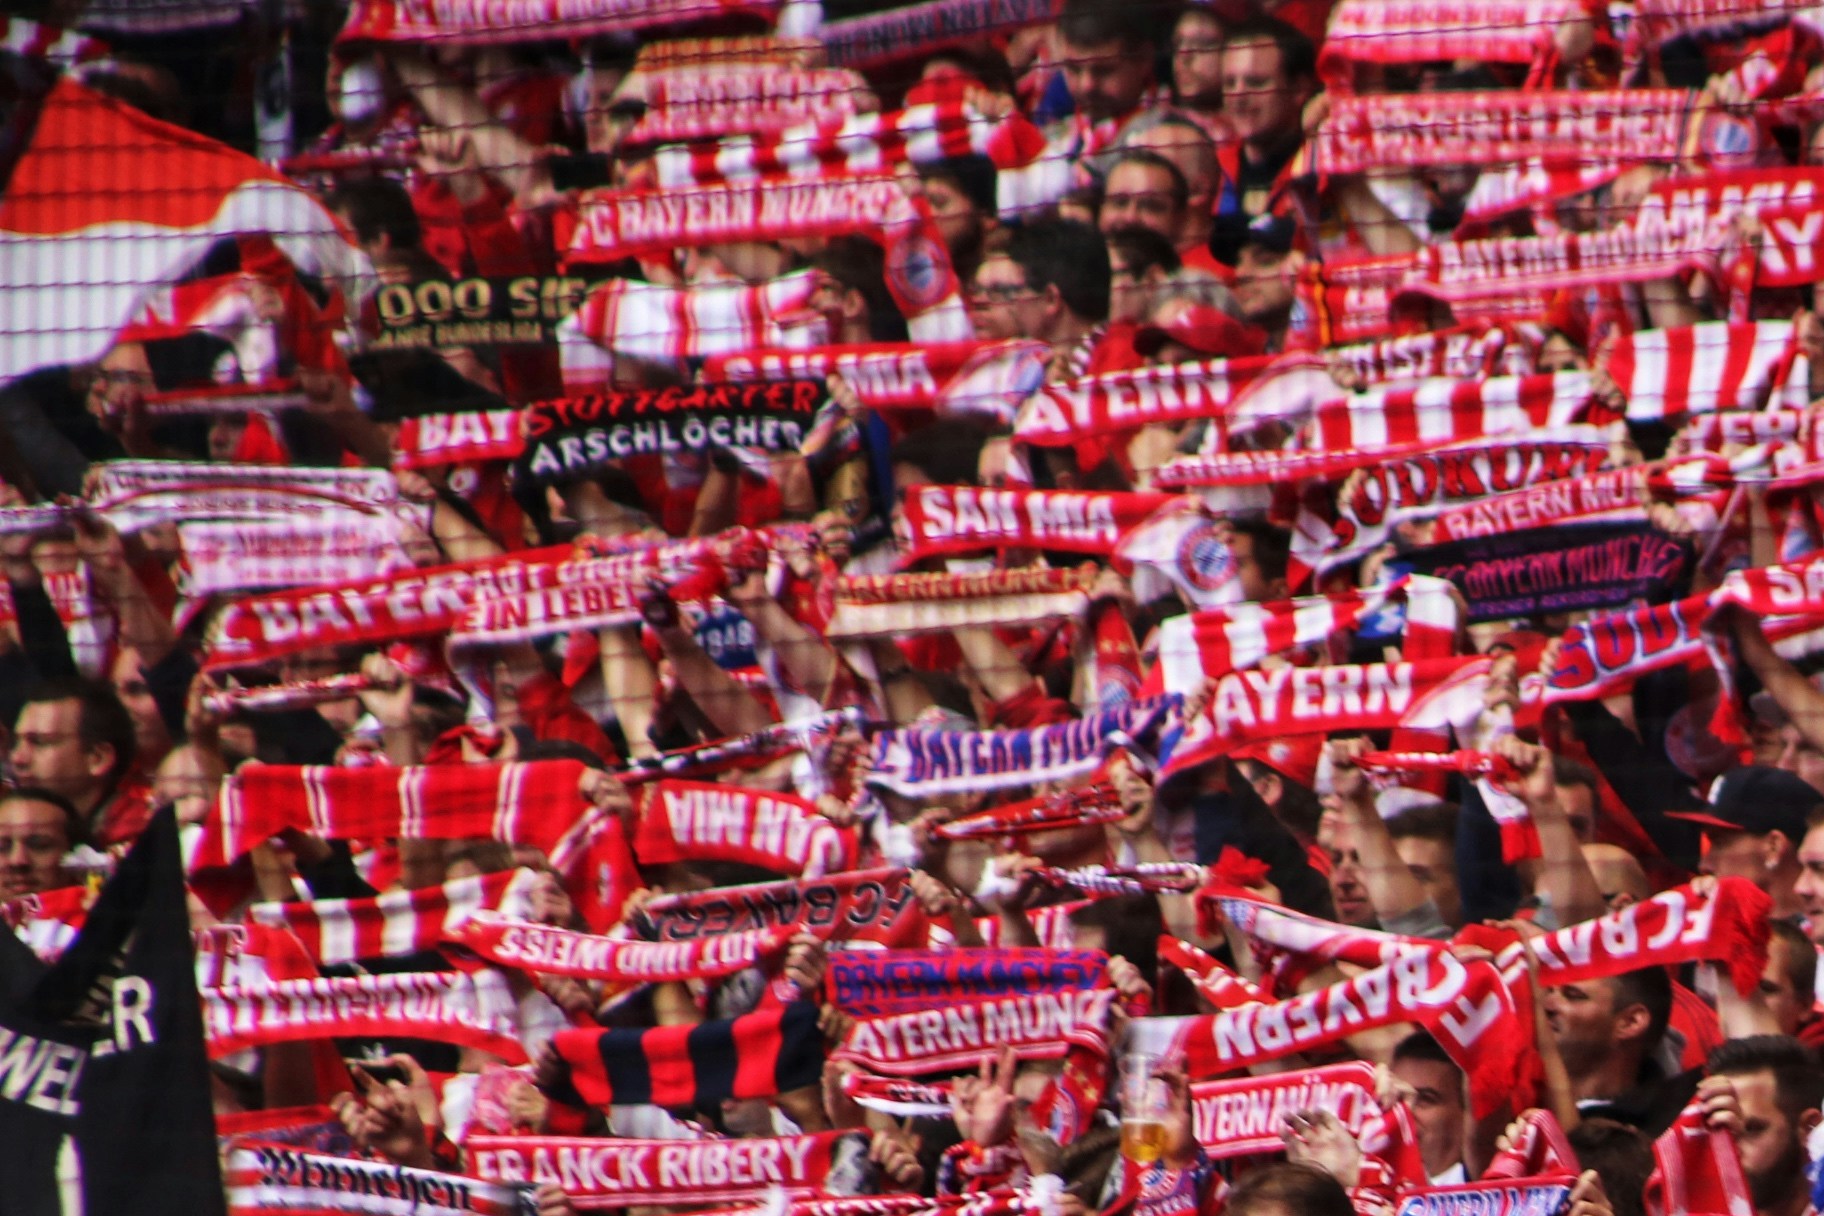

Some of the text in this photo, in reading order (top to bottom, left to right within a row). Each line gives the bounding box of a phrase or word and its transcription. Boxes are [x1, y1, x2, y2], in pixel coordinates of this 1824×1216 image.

[419, 412, 513, 452] BAY
[920, 489, 1116, 539] SAN MIA
[474, 1133, 814, 1189] FRANCK RIBERY
